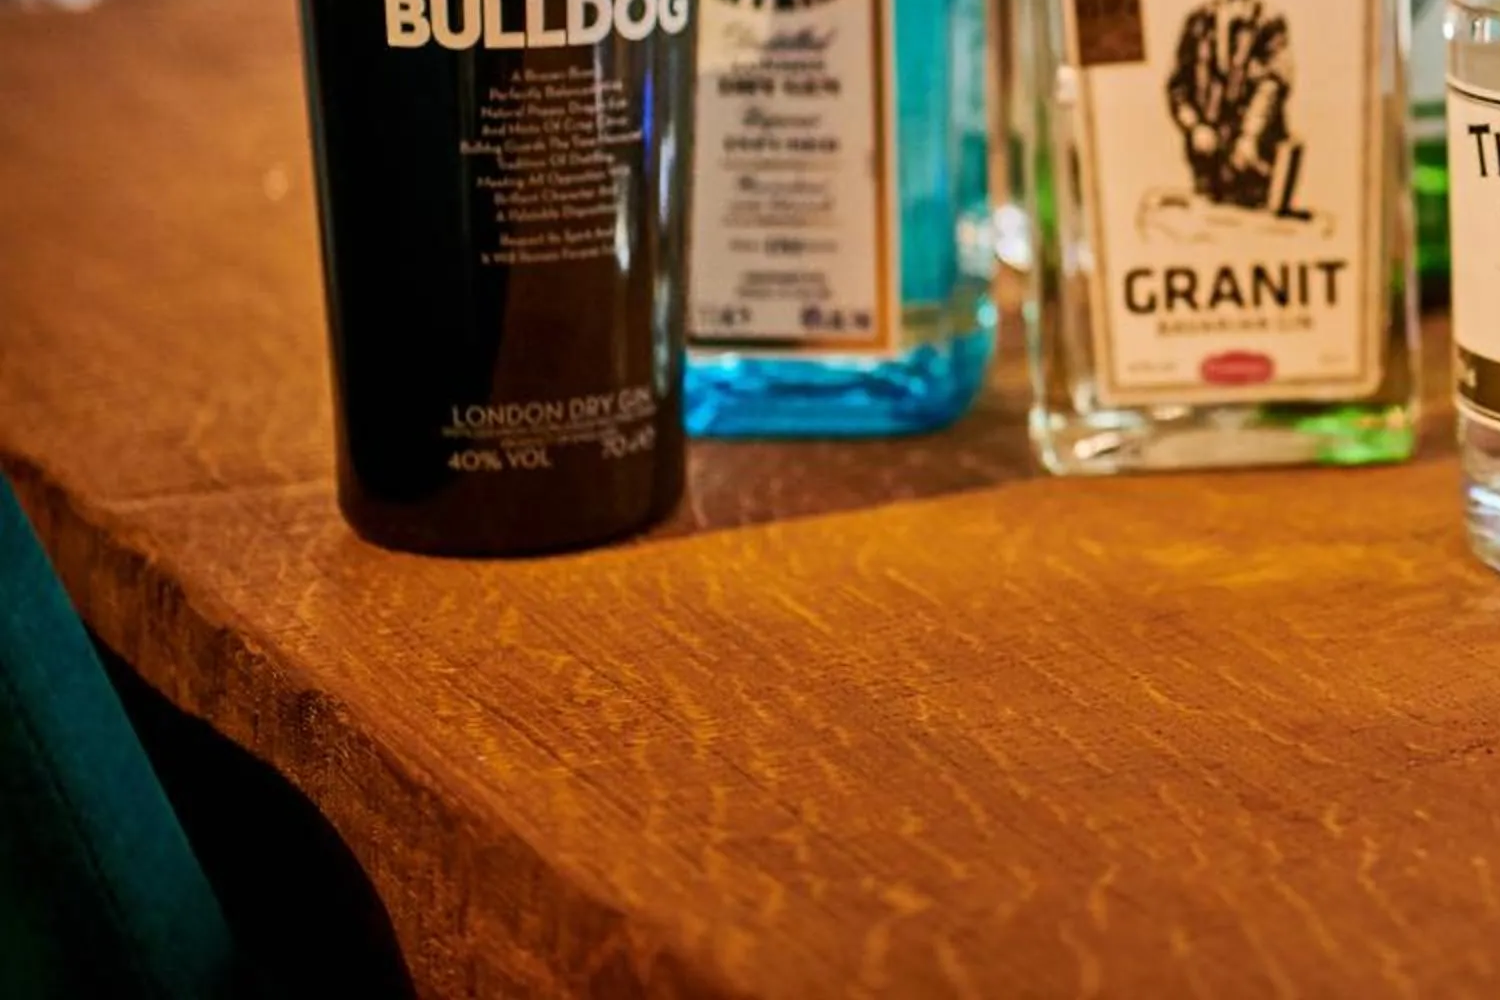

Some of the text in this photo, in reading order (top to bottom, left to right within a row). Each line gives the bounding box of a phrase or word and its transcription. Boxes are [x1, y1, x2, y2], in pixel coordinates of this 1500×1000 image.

[1124, 258, 1347, 315] GRANIT
[452, 400, 564, 427] LONDON
[569, 392, 614, 421] DRY
[447, 447, 552, 471] 40% VOL
